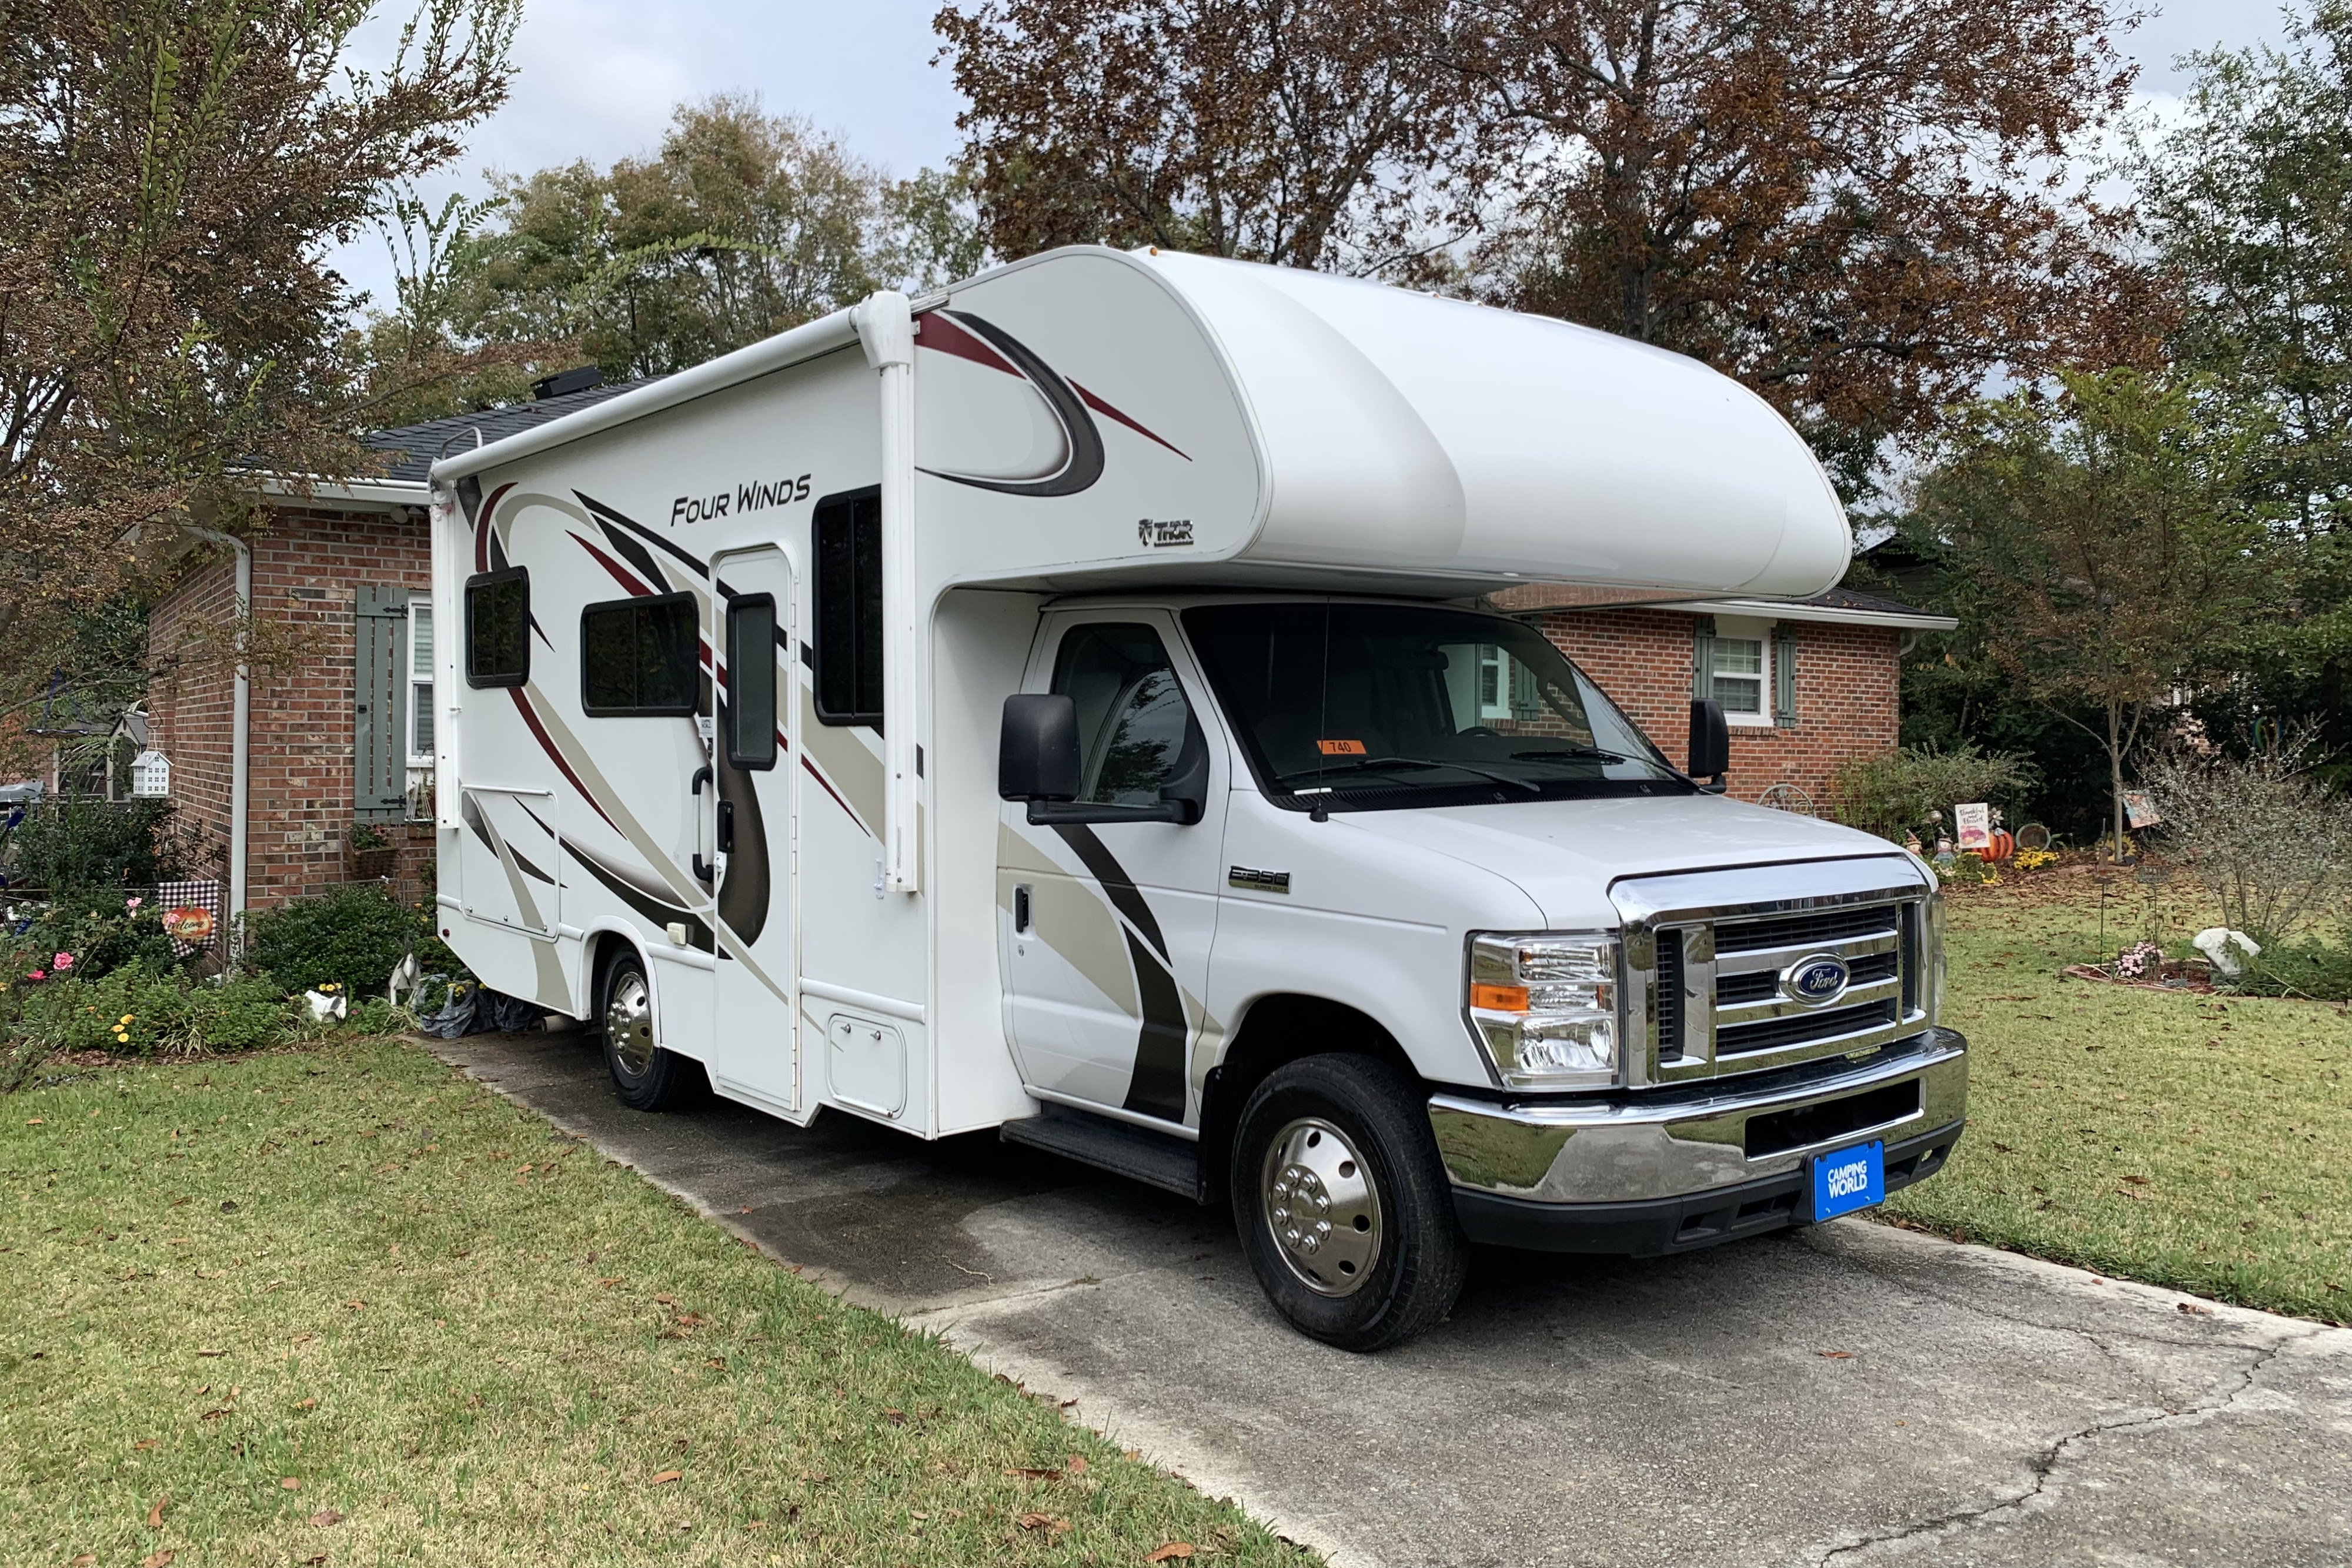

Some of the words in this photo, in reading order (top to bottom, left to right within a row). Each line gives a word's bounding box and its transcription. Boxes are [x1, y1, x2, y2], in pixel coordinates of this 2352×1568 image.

[670, 493, 730, 527] FOUR
[737, 473, 811, 514] WINDS
[1329, 741, 1352, 753] 740
[1809, 968, 1839, 990] Ford
[1828, 1160, 1867, 1183] CAMPING
[1828, 1174, 1867, 1199] WORLD
